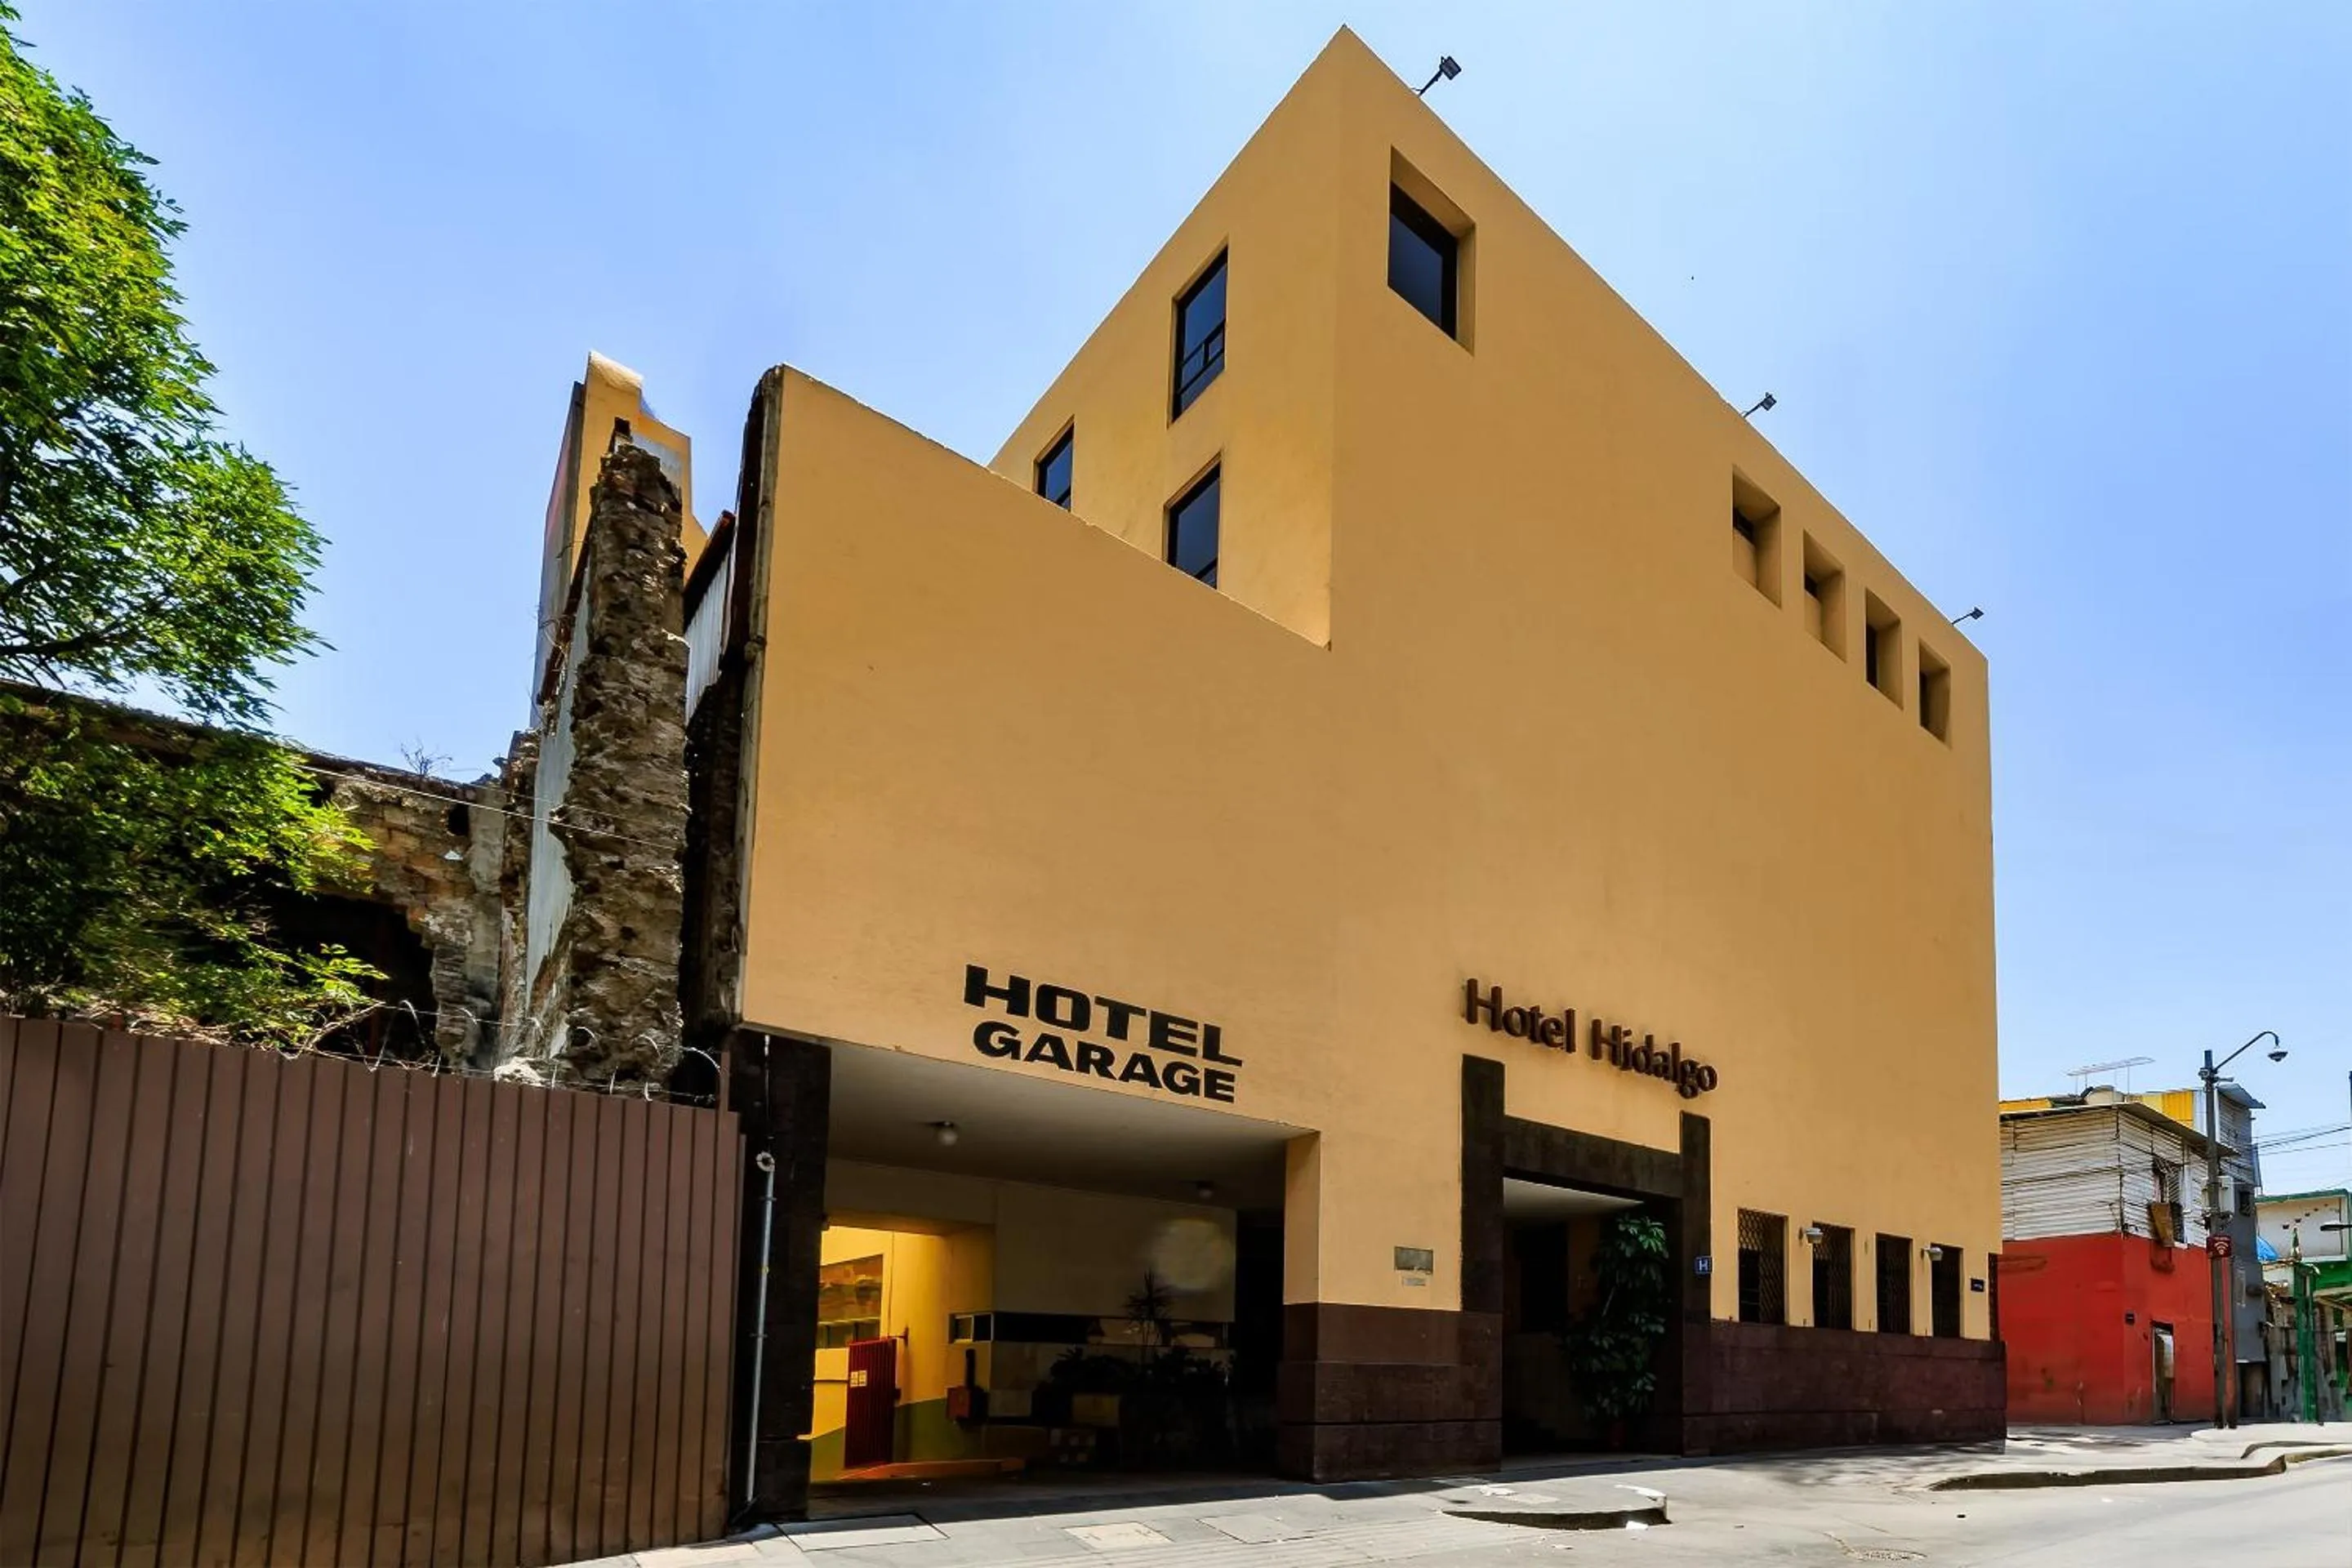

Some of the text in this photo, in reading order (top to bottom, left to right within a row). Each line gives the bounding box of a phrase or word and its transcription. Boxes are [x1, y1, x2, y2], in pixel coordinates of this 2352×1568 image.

[964, 964, 1242, 1067] HOTEL
[973, 1021, 1235, 1102] GARAGE
[1467, 978, 1717, 1099] Hotel Hidalgo
[1699, 1259, 1708, 1271] H
